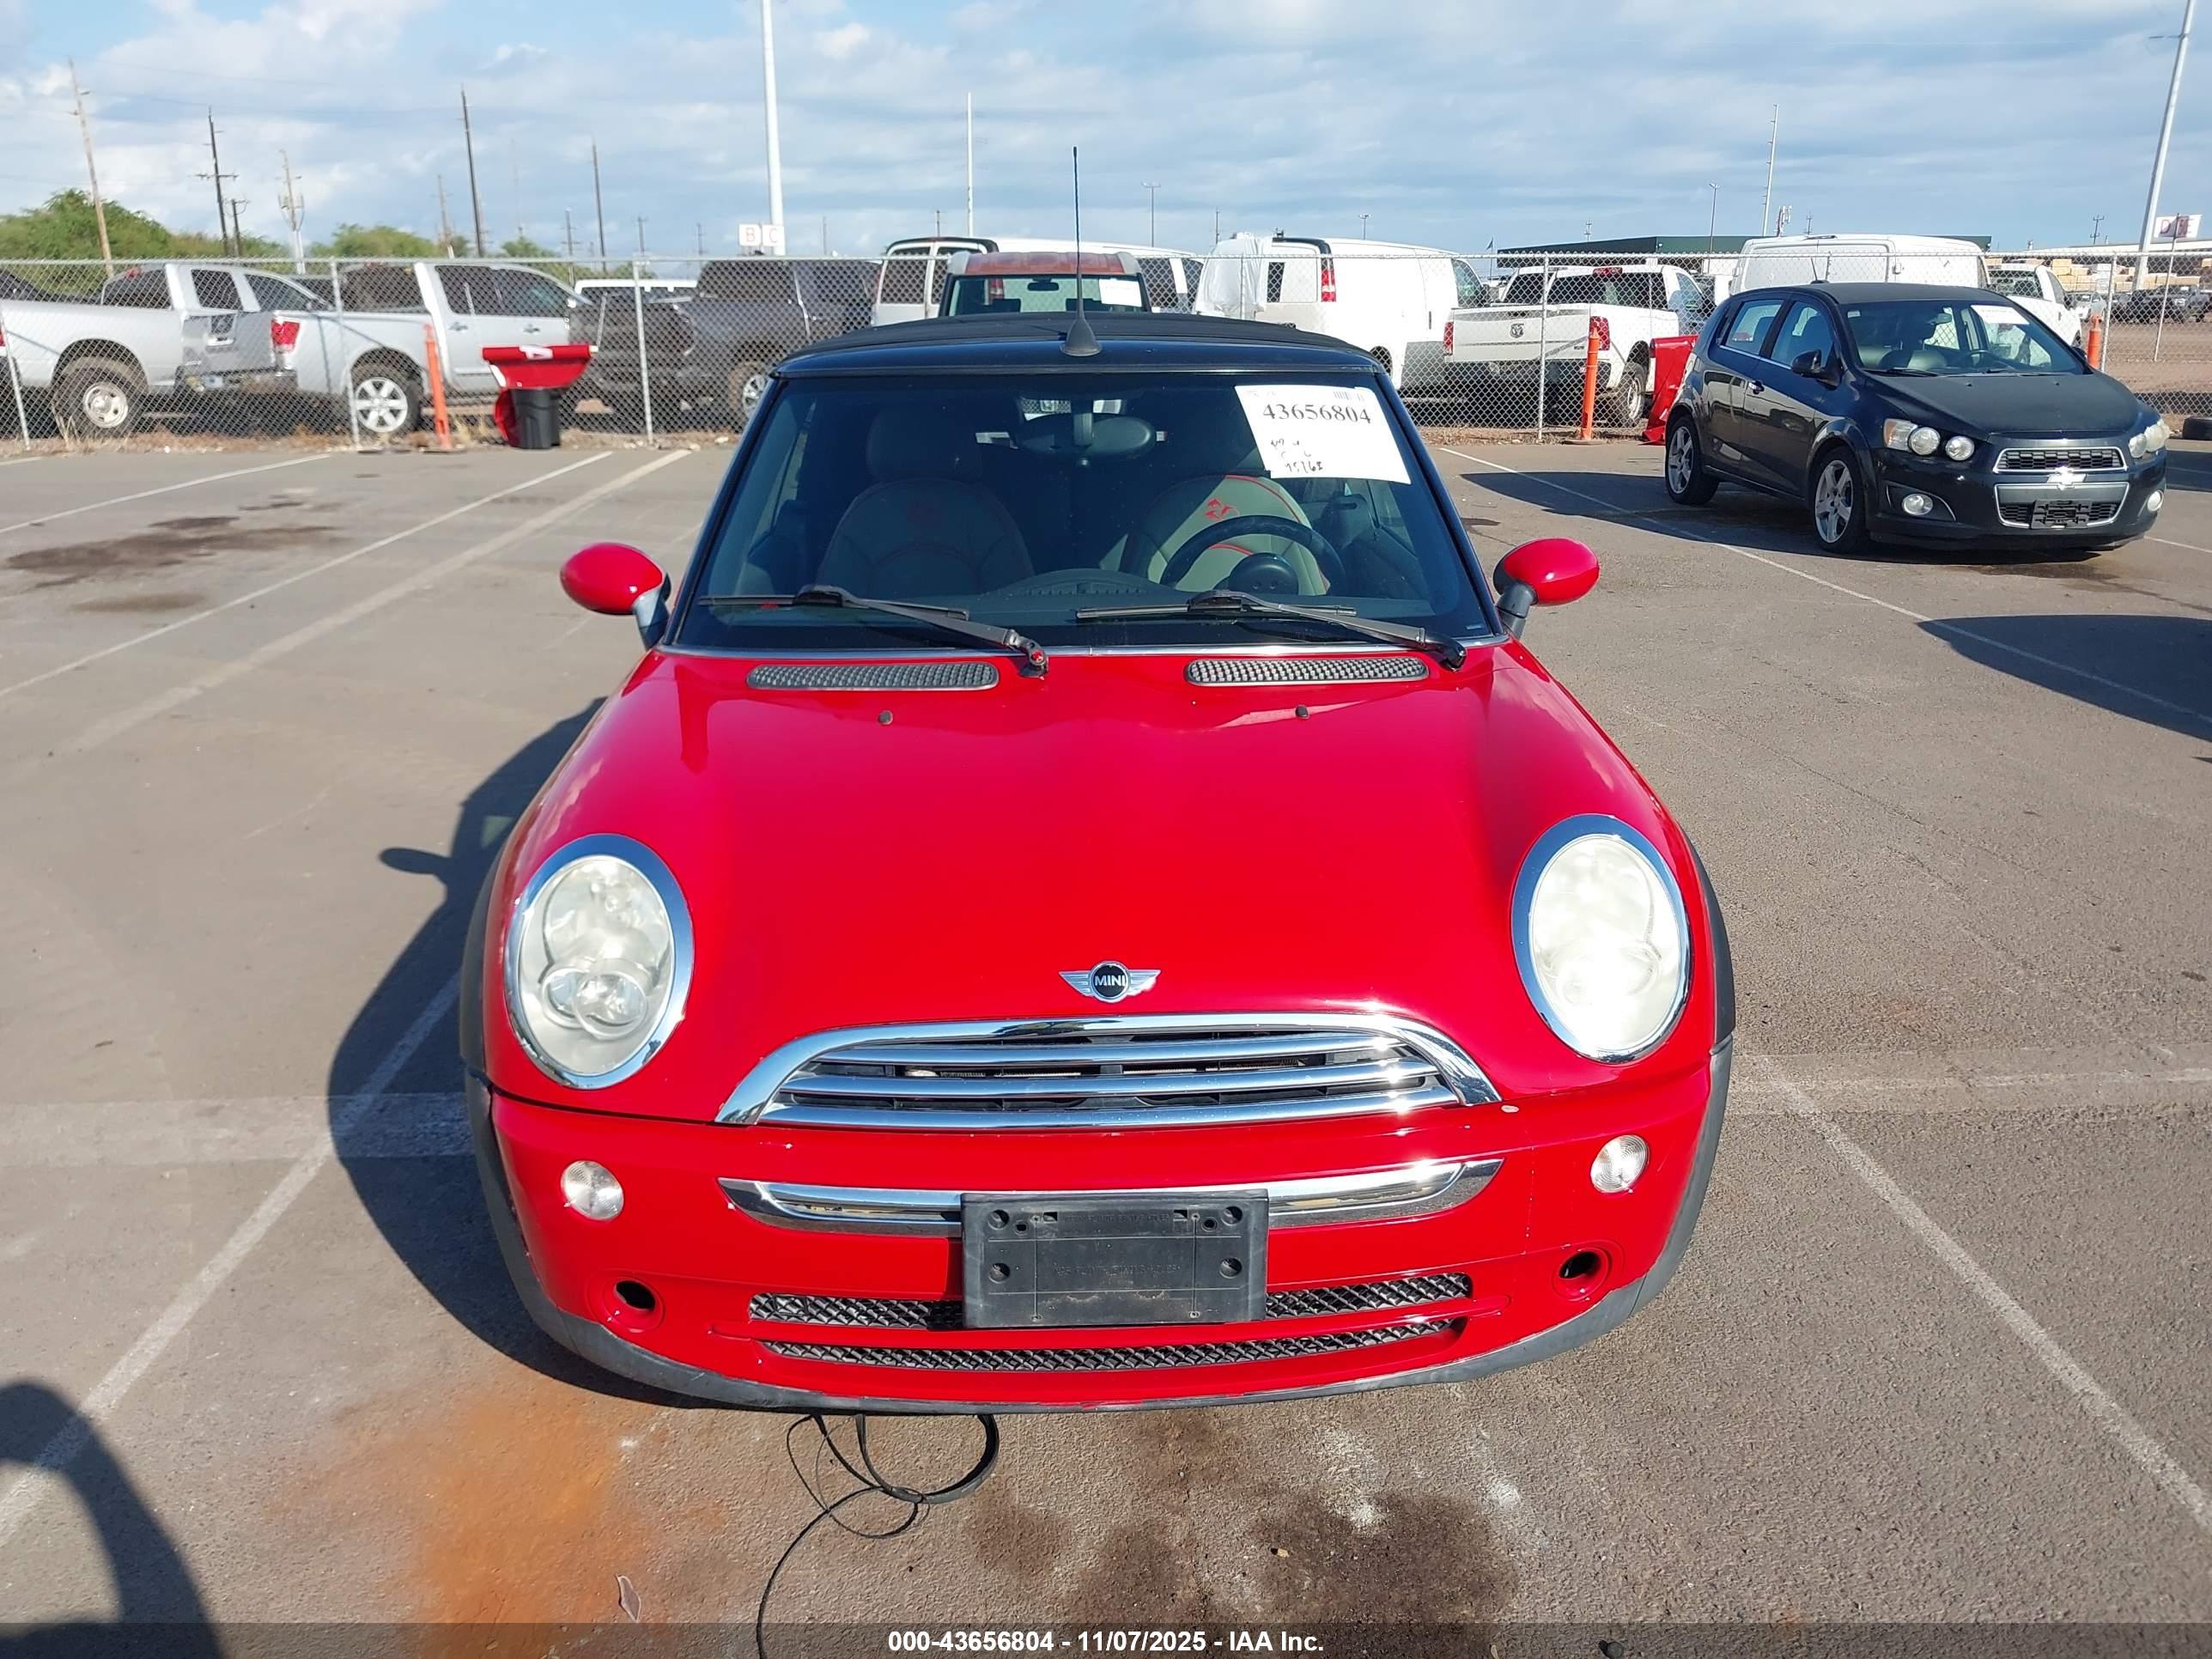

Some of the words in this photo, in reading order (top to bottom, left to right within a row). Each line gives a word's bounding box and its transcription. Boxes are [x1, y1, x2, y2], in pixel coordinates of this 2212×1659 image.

[745, 227, 756, 242] B
[769, 227, 778, 244] C
[1262, 404, 1371, 424] 43656804
[1094, 975, 1127, 987] MINI
